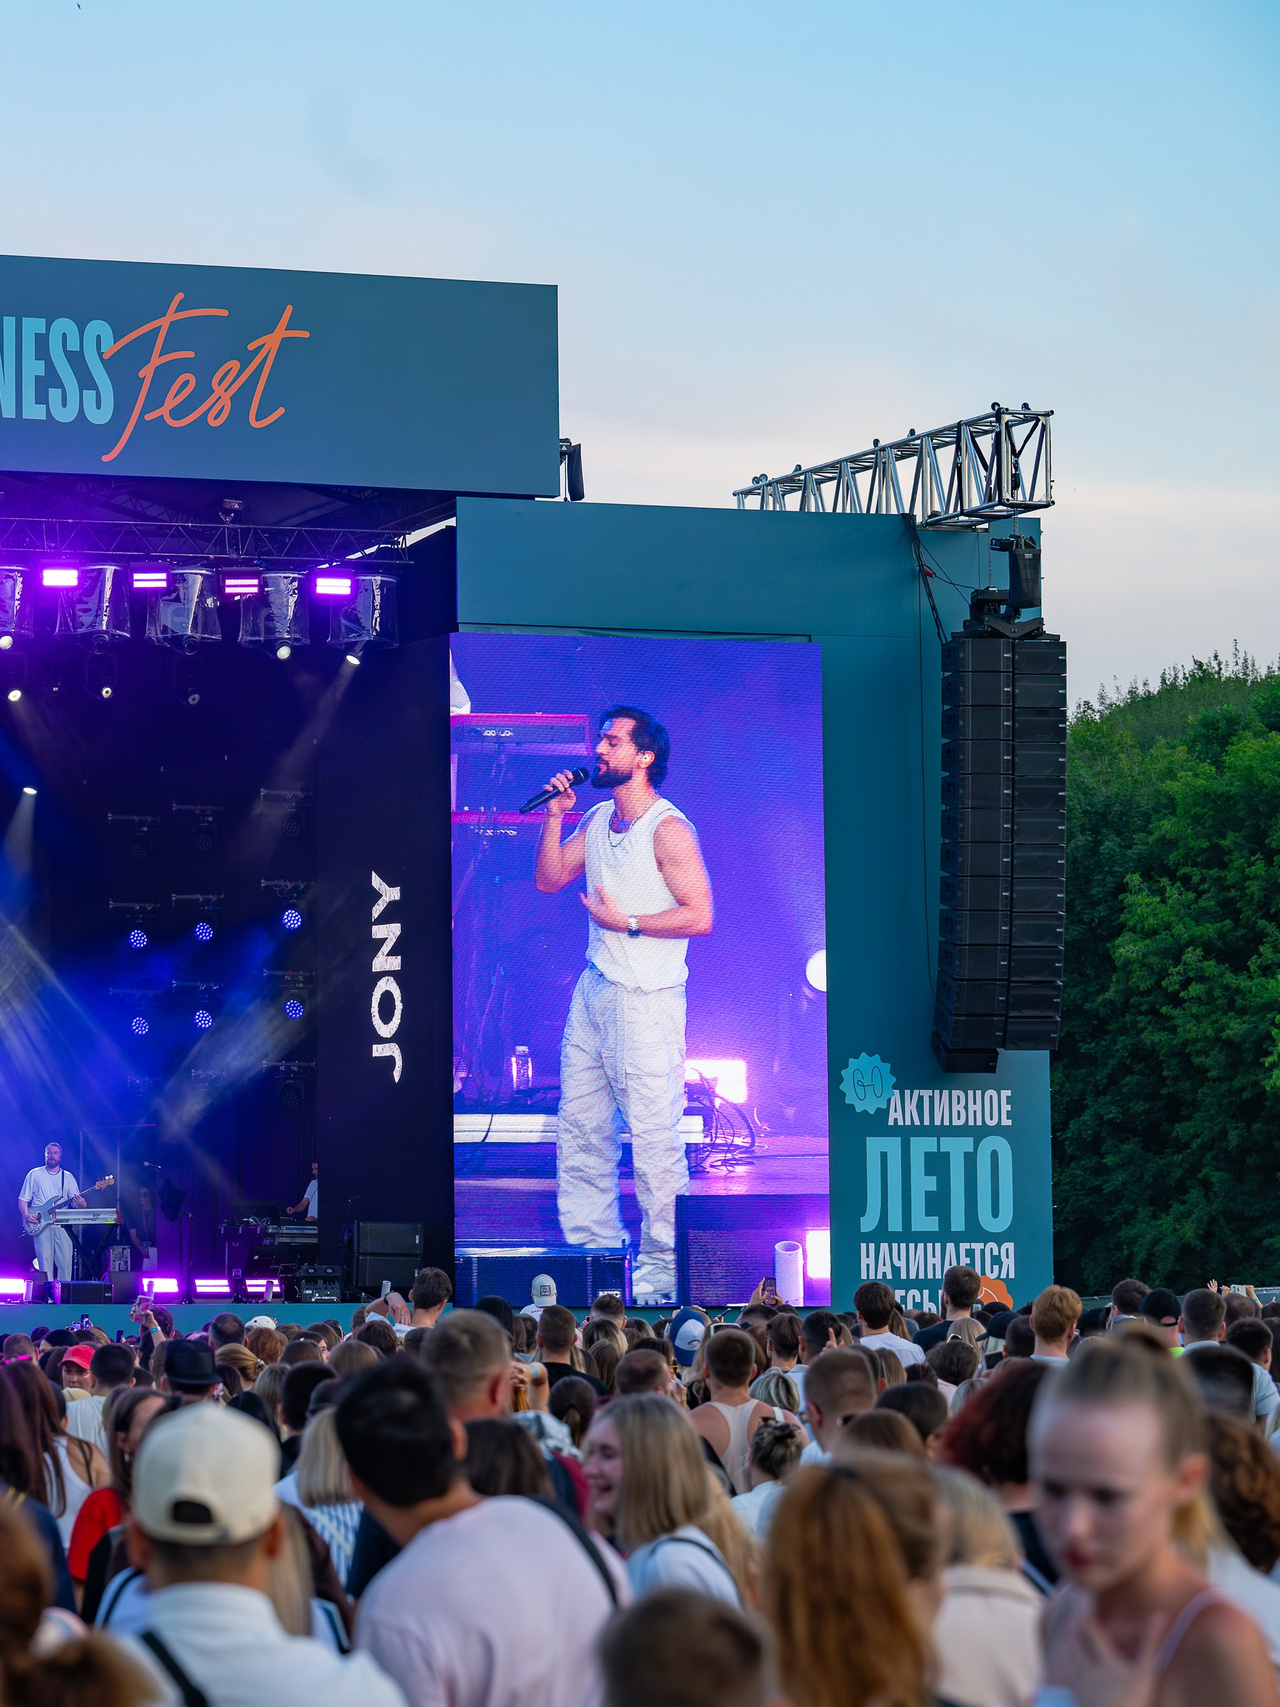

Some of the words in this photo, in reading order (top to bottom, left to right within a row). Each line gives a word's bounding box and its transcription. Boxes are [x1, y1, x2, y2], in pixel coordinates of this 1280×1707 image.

[102, 292, 310, 463] Fest
[370, 870, 403, 1084] JONY
[887, 1089, 1012, 1126] АКТИВНОЕ
[860, 1135, 1014, 1233] ЛЕТО
[860, 1242, 1015, 1280] НАЧИНАЕТСЯ
